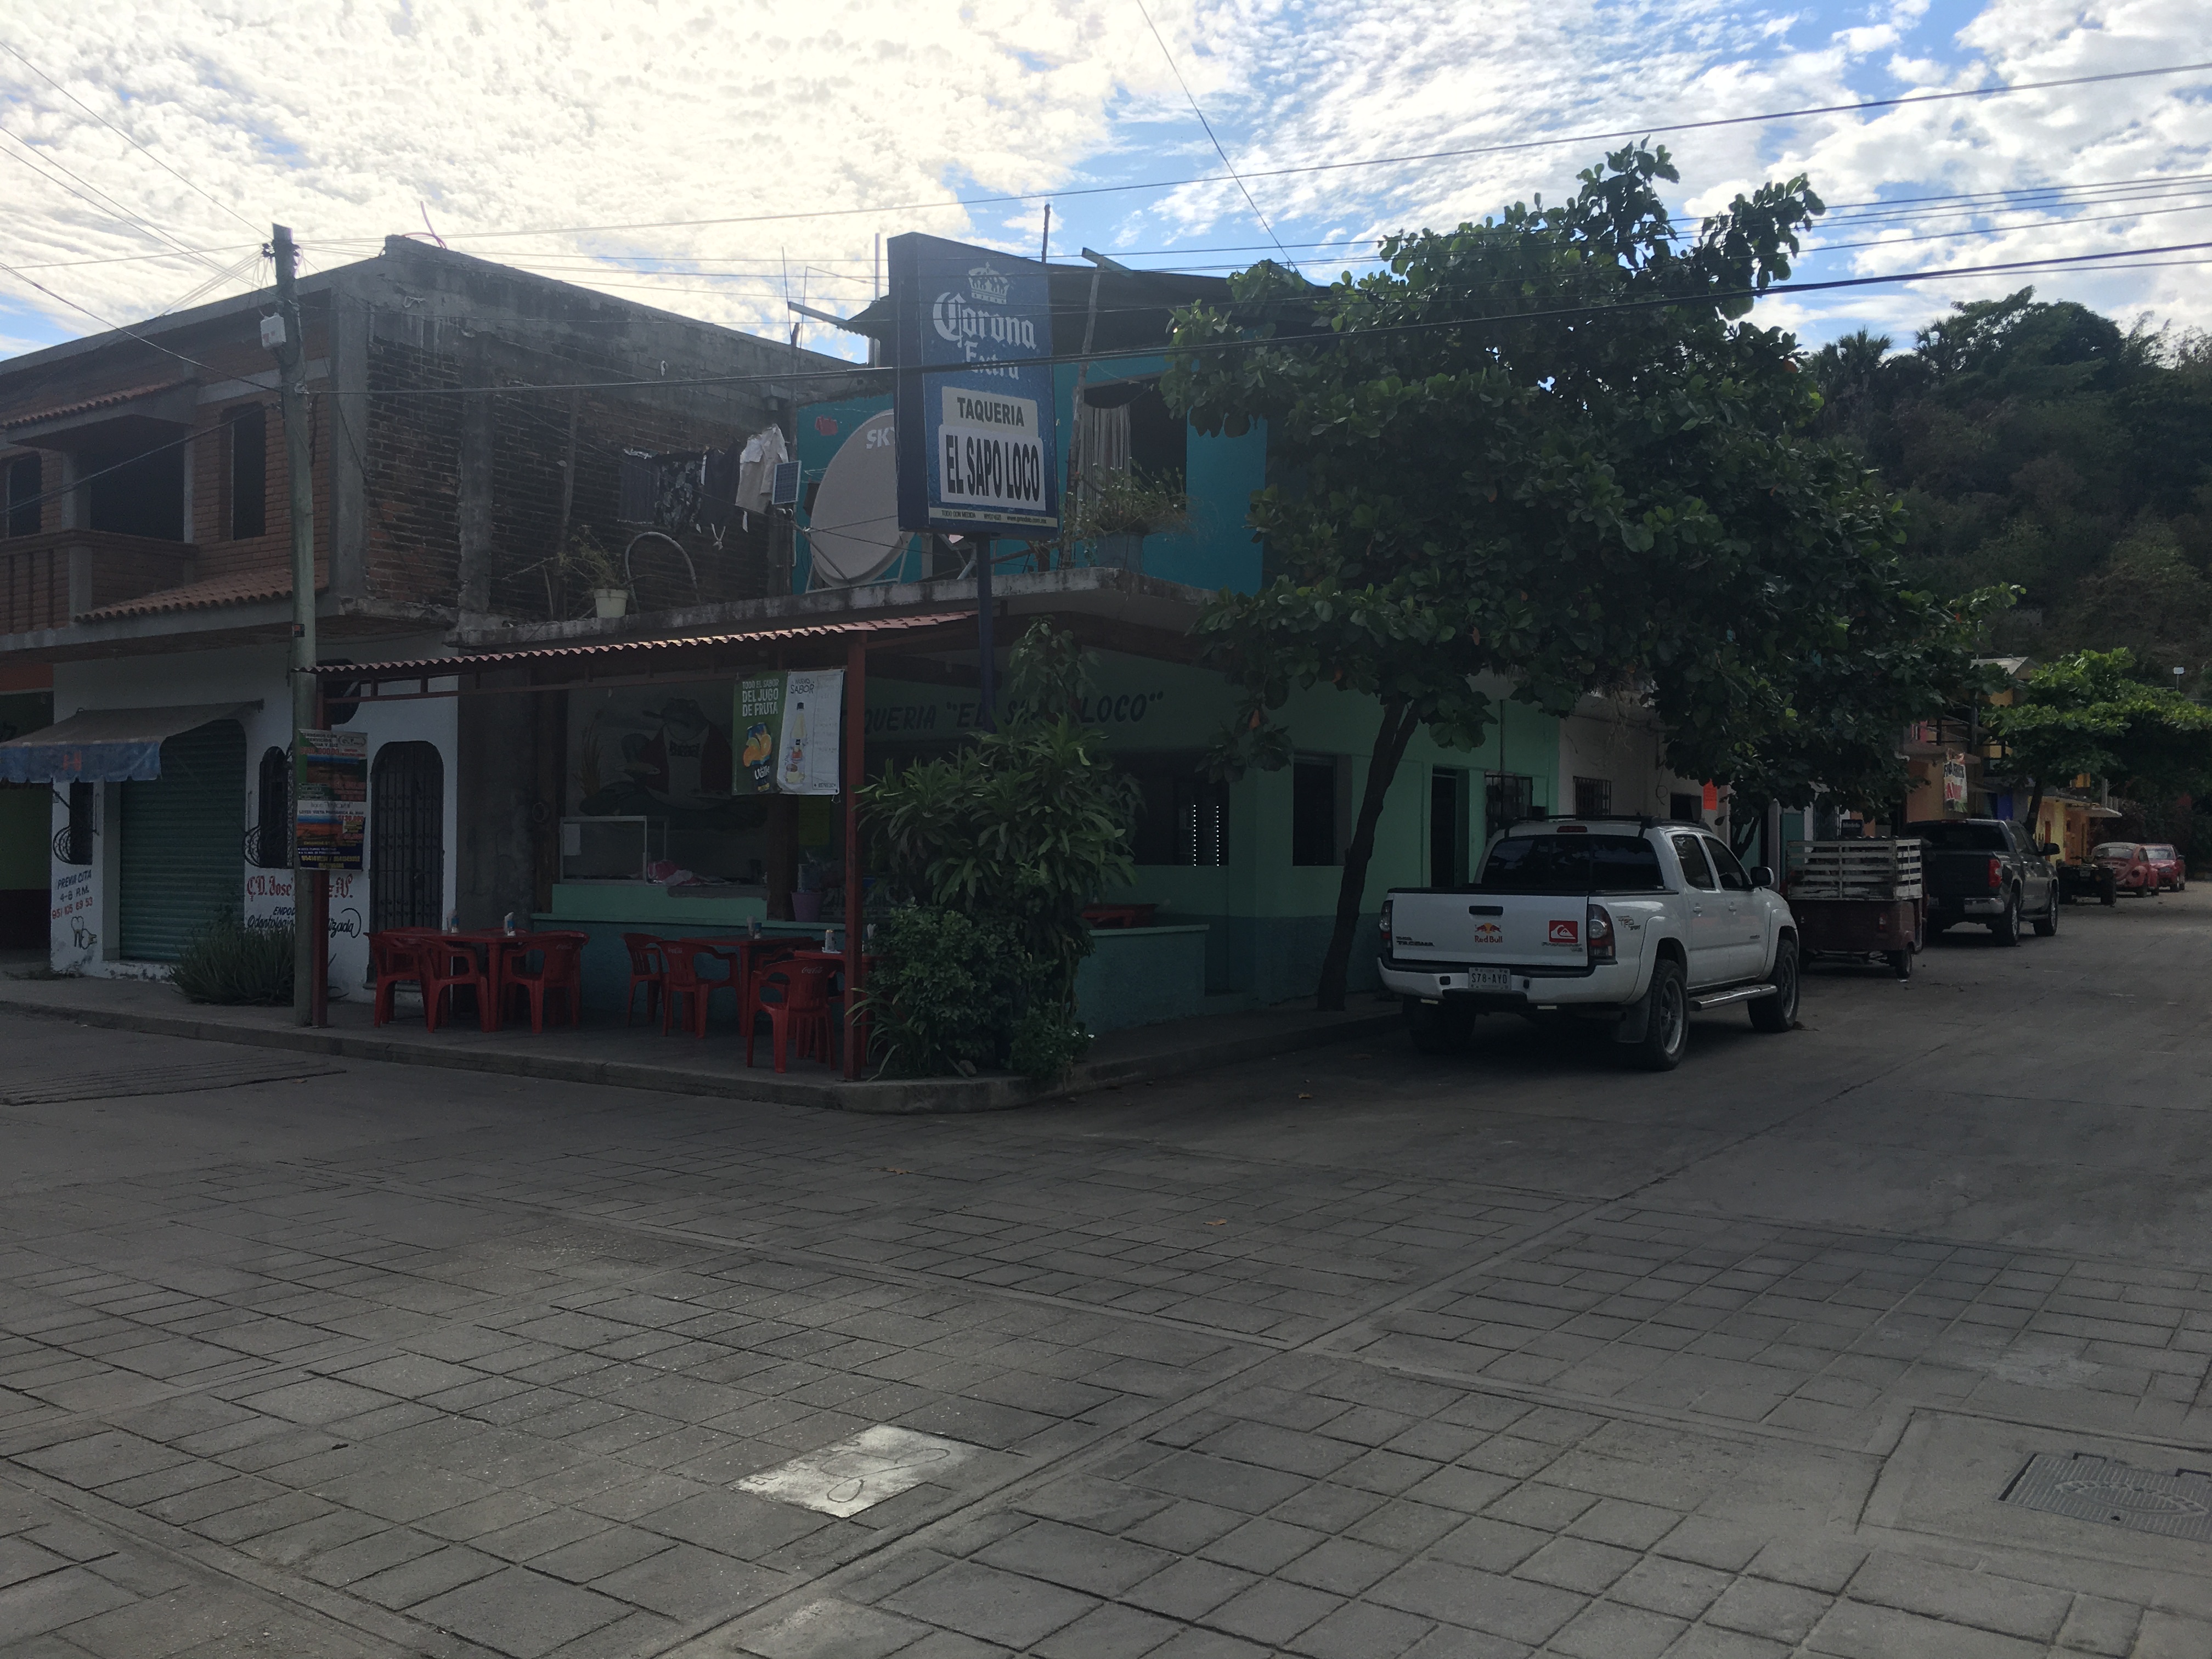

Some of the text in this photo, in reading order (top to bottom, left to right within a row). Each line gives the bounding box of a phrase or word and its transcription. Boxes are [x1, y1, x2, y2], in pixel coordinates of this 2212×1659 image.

[933, 292, 1036, 350] Corona
[957, 397, 1024, 427] TAQUERIA
[866, 426, 895, 449] SK
[946, 435, 1040, 502] EL SAPO LOCO
[742, 680, 755, 689] TODO
[763, 679, 779, 687] SABOR
[791, 684, 814, 694] SABOR
[742, 688, 778, 702] DEL JUGO
[742, 702, 778, 716] DE FRUTA
[58, 870, 92, 889] PREVIA CITA
